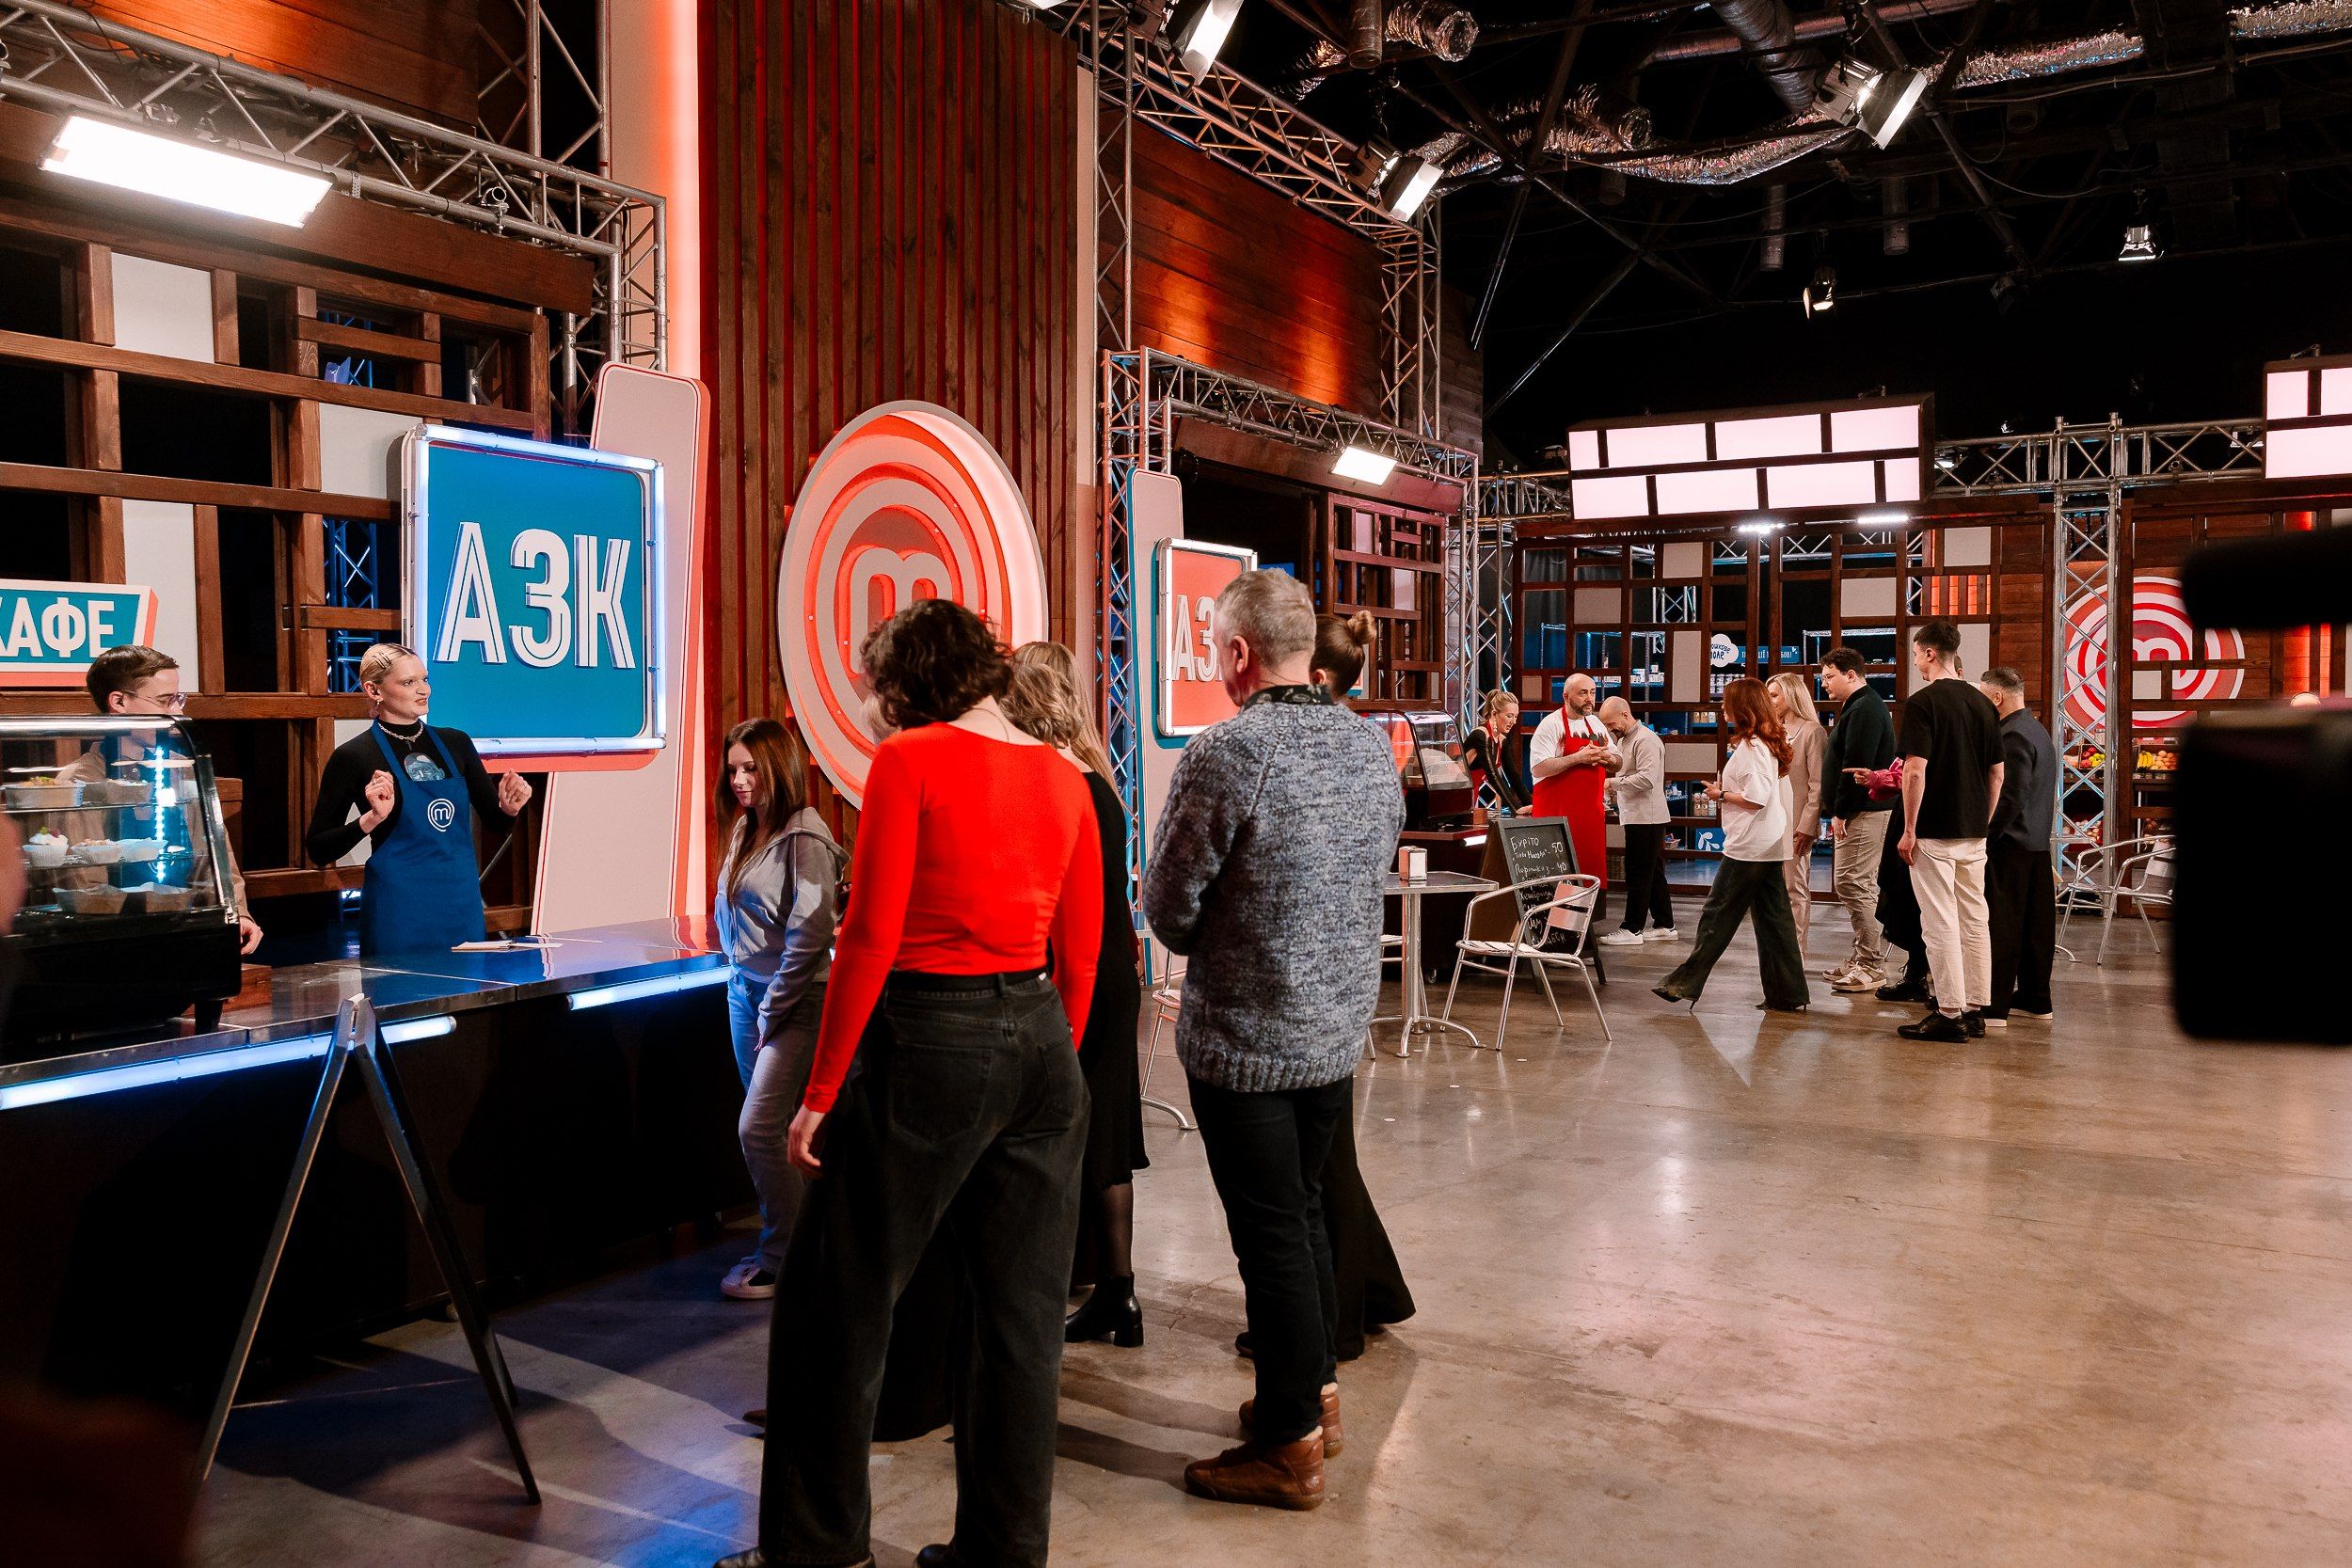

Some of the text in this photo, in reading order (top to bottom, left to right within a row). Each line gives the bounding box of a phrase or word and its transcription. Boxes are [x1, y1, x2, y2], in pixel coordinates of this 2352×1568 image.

[0, 596, 115, 658] АФЕ
[433, 522, 636, 668] АЗК
[1172, 594, 1223, 682] АЗ
